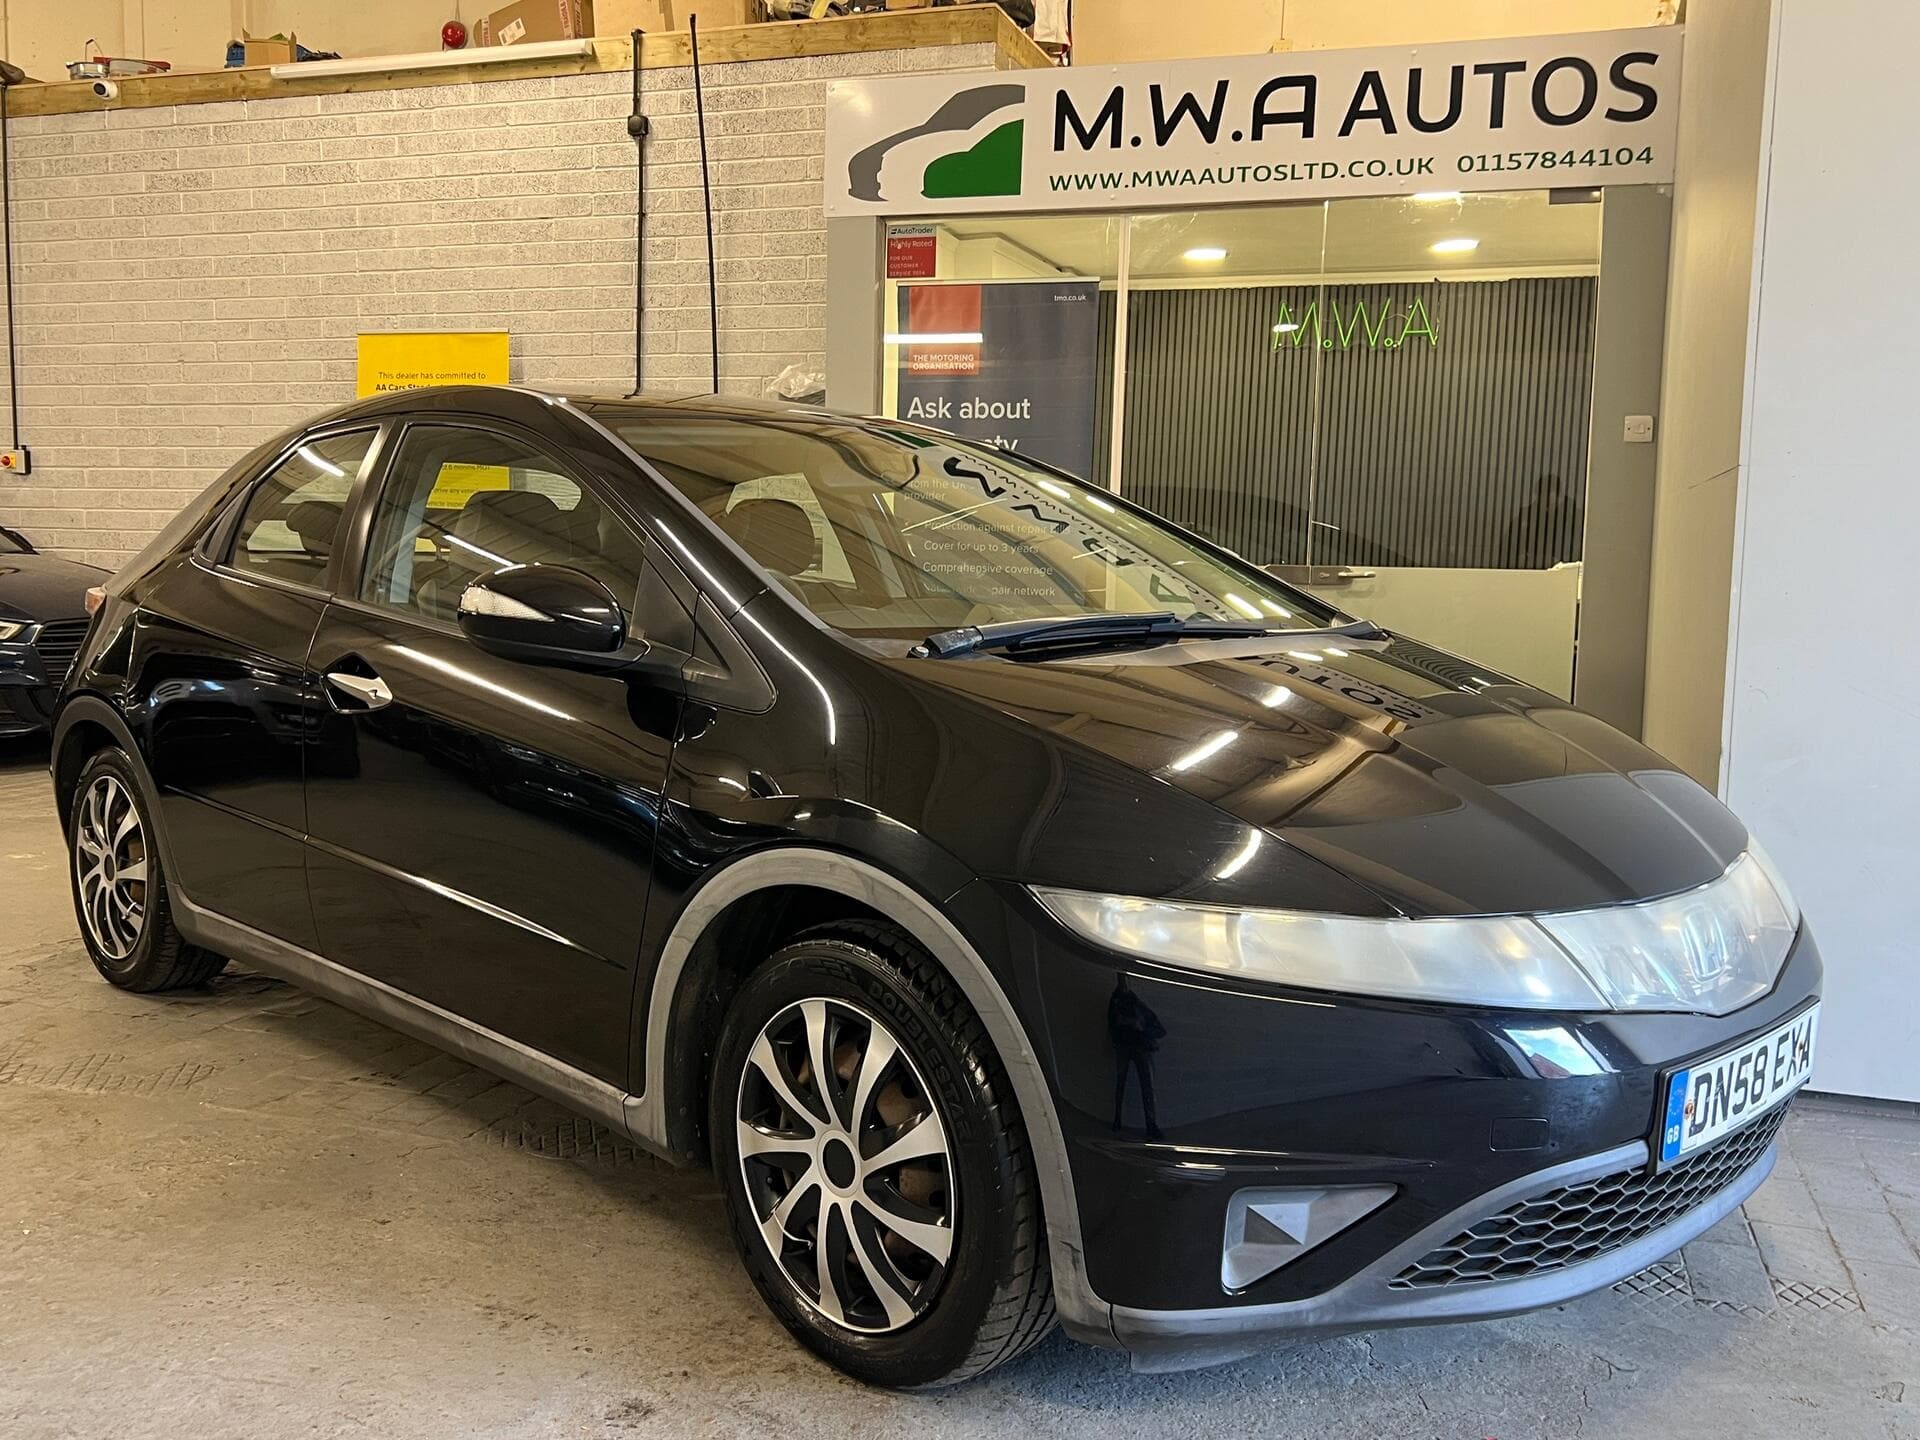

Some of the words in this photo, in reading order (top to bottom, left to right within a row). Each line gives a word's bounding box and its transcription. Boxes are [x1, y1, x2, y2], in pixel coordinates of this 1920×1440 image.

[1053, 74, 1317, 152] M.W.A
[1337, 51, 1660, 138] AUTOS
[1049, 157, 1434, 192] WWW.MWAAUTOSLTD.CO.UK
[1456, 146, 1655, 173] 01157844104
[1053, 293, 1087, 302] tmo.co.uk
[1273, 297, 1436, 349] M.W.A
[912, 354, 929, 362] THE
[929, 353, 974, 362] MOTORING
[912, 362, 975, 371] ORGANISATION
[378, 371, 394, 380] This
[395, 371, 419, 380] dealer
[420, 371, 433, 380] has
[434, 371, 477, 380] committed
[478, 371, 487, 380] to
[906, 396, 953, 420] Ask
[958, 396, 1031, 420] about
[979, 522, 1015, 535] against
[923, 540, 955, 551] Cover
[957, 541, 972, 551] for
[973, 543, 987, 554] up
[988, 542, 999, 552] to
[1001, 543, 1008, 552] 3
[1010, 544, 1040, 554] years
[922, 561, 1002, 574] Comprehensive
[1004, 564, 1053, 578] coverage
[1013, 585, 1056, 598] network
[1687, 1044, 1769, 1138] DN58
[1665, 1125, 1680, 1144] GB
